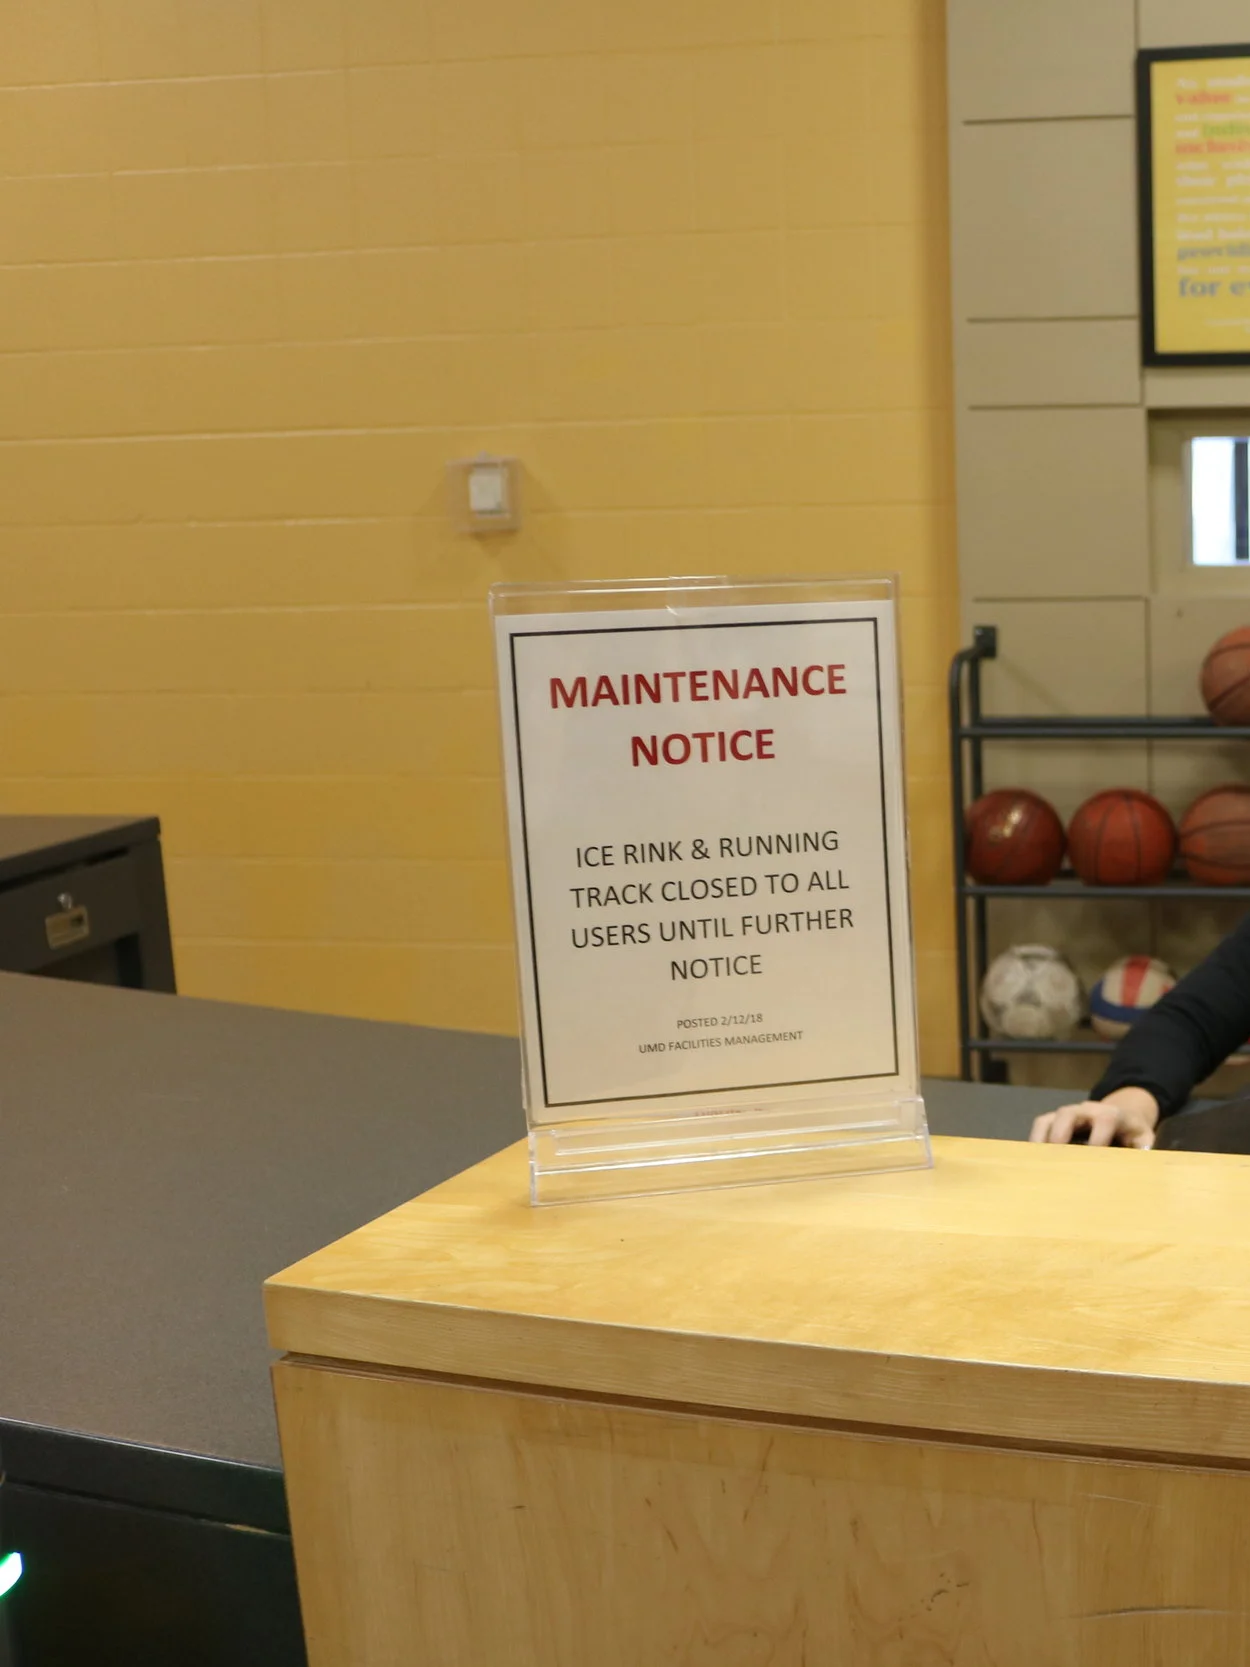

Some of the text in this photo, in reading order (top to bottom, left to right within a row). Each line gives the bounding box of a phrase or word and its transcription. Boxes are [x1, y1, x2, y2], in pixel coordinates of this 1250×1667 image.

[1179, 277, 1222, 298] for
[550, 664, 846, 709] MAINTENANCE
[632, 729, 775, 767] NOTICE
[576, 831, 839, 868] ICE RINK & RUNNING
[570, 869, 850, 909] TRACK CLOSED TO ALL
[571, 909, 854, 949] USERS UNTIL FURTHER
[670, 955, 763, 981] NOTICE
[676, 1012, 764, 1030] POSTED 2/12/18
[638, 1030, 804, 1054] UMD FACILITIES MANAGEMENT
